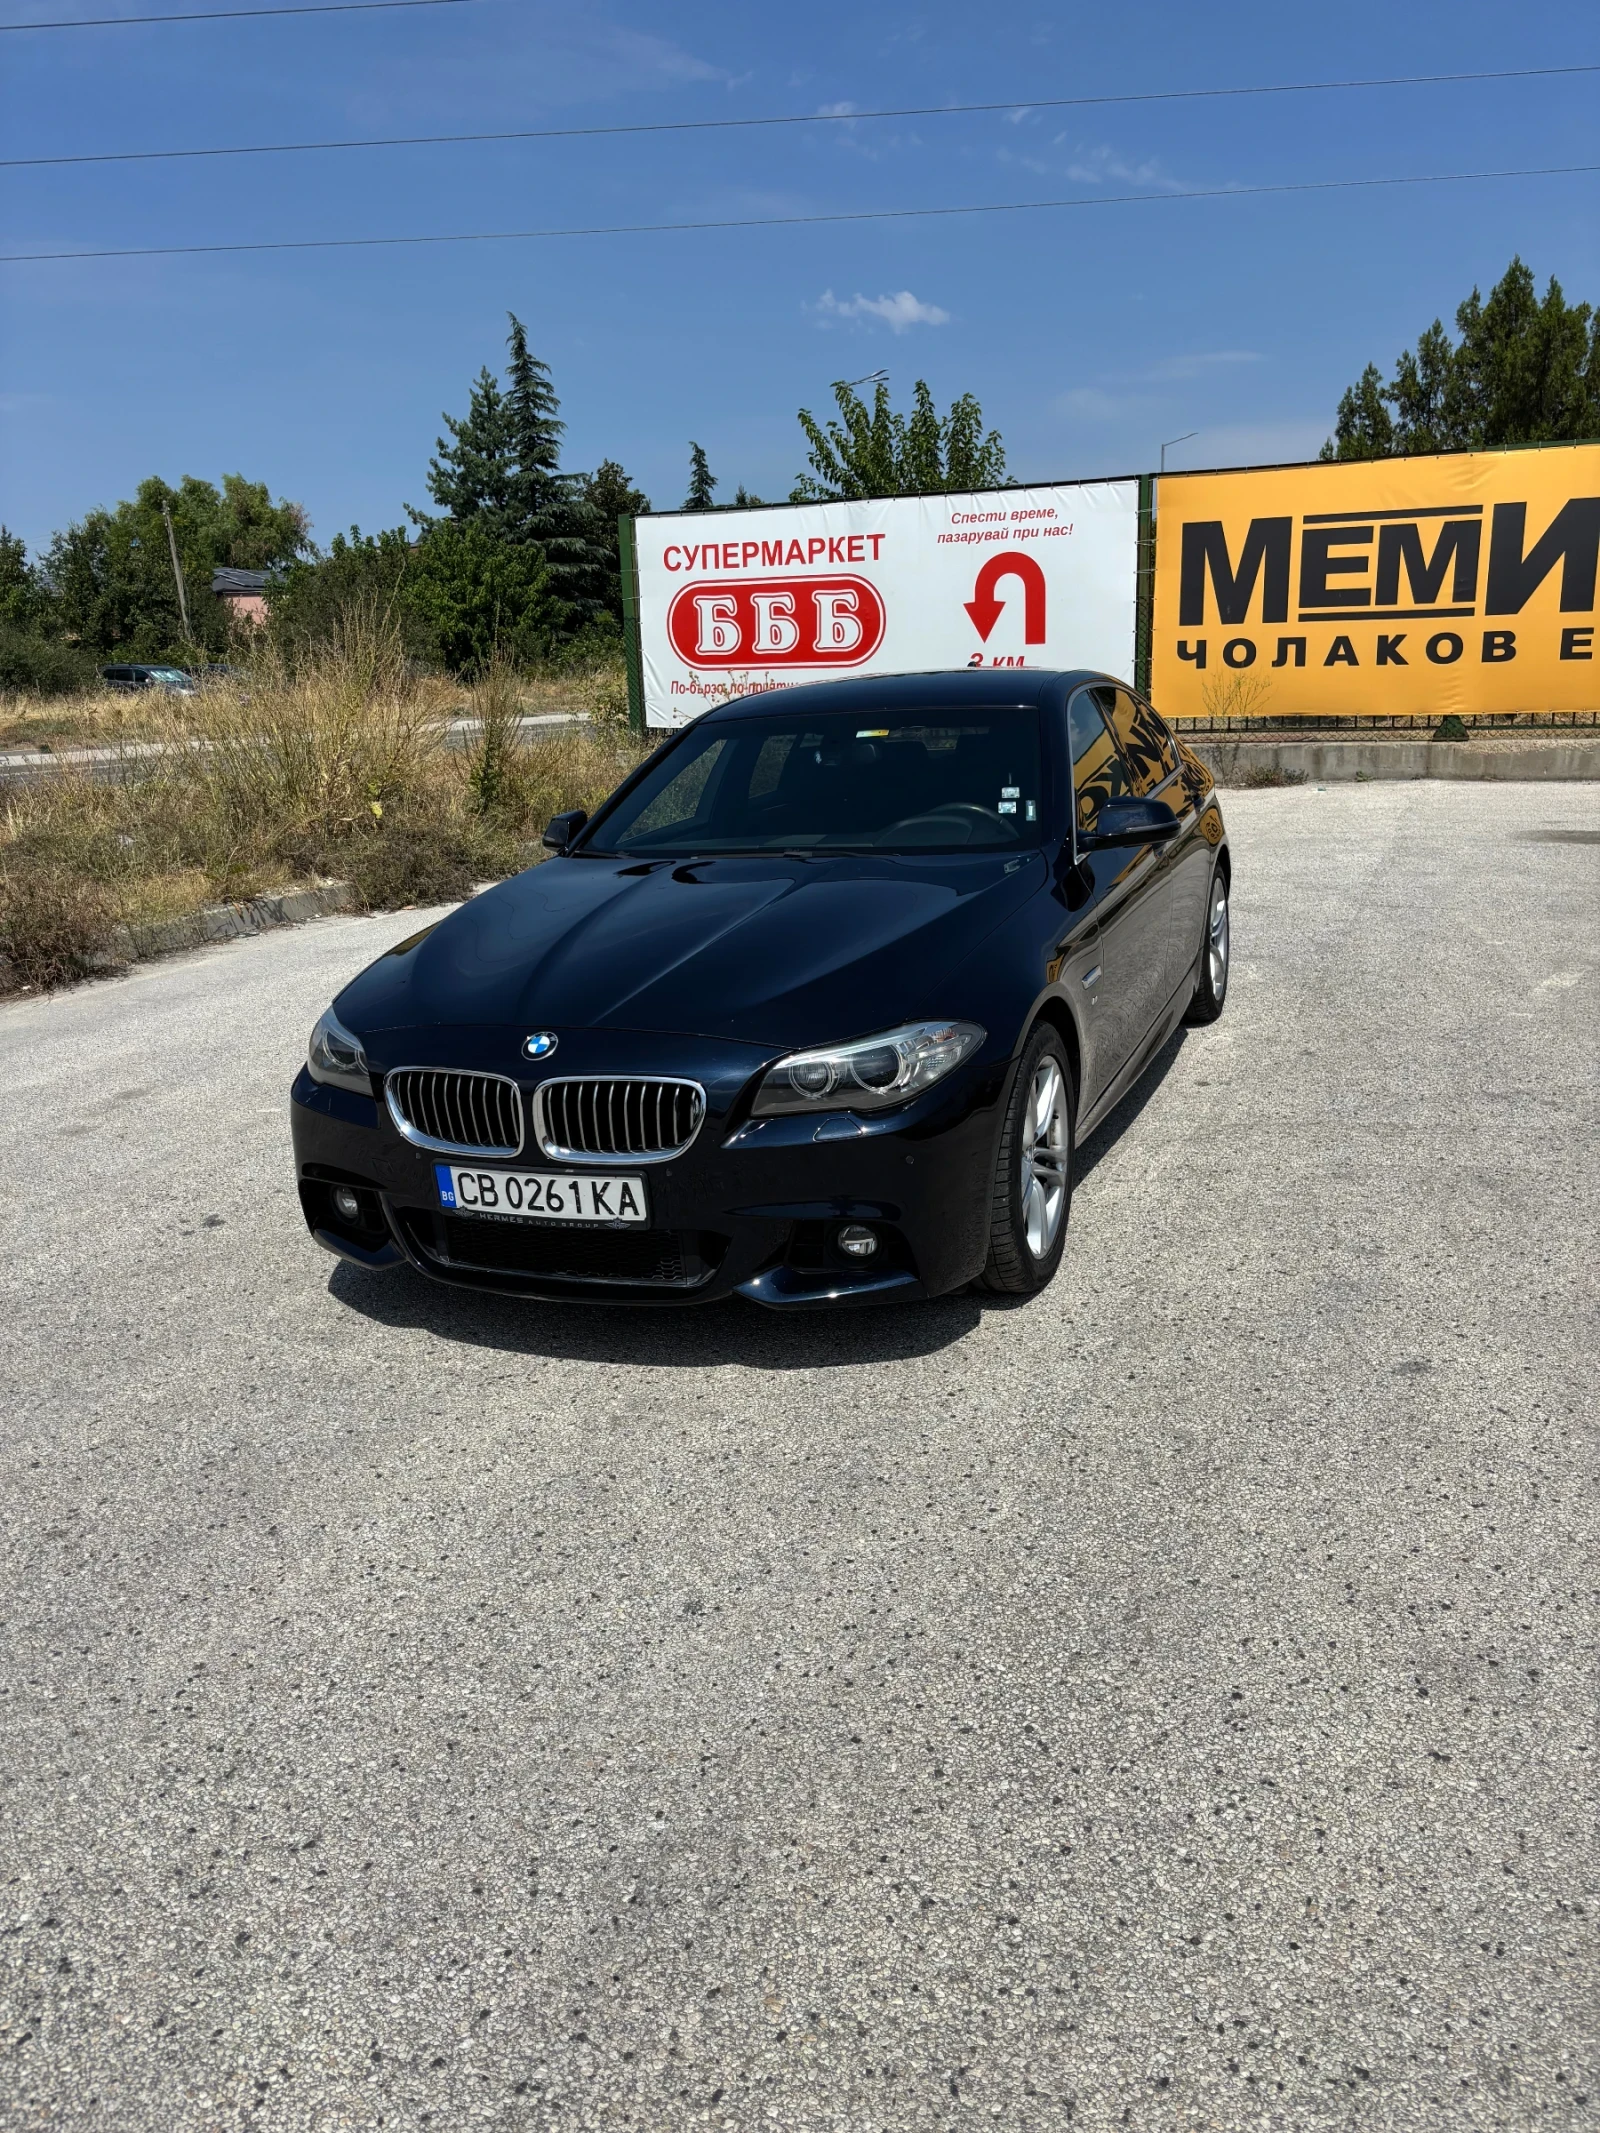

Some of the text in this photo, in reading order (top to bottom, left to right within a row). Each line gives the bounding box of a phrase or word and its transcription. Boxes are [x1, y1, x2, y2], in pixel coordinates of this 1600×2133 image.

[951, 507, 1059, 525] Спести време,
[937, 523, 1074, 545] пазарувай при нас!
[663, 533, 886, 572] СУПЕРМАРКЕТ
[1179, 496, 1600, 626] МЕМИ
[1177, 627, 1595, 669] ЧОЛАКОВ Е
[441, 1190, 454, 1202] BG
[457, 1172, 640, 1216] CB 0261 KA
[480, 1212, 524, 1224] HERMES
